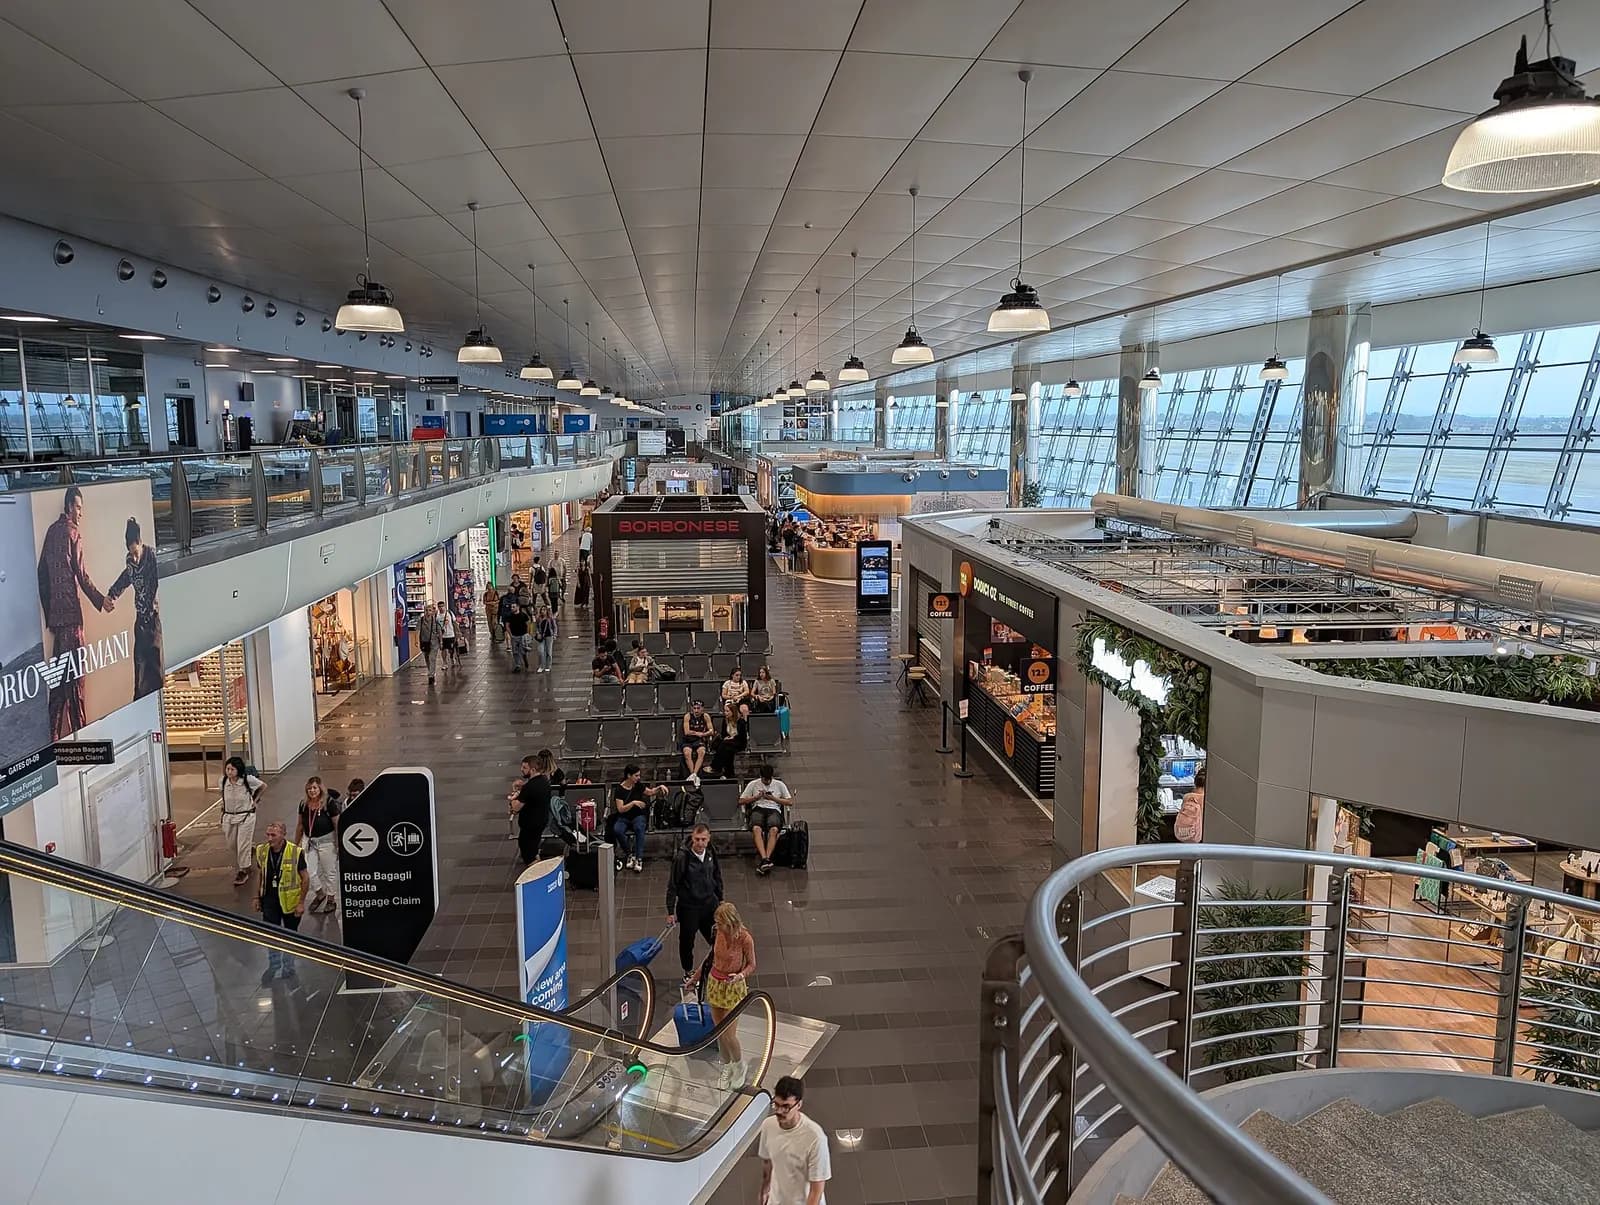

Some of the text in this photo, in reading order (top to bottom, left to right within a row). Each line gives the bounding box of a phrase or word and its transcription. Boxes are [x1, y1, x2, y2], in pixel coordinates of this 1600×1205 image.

[619, 520, 740, 533] BORBONESE
[973, 576, 990, 597] DODICI
[1018, 604, 1035, 619] COFFEE
[0, 630, 130, 709] RIO ARMANI
[1023, 683, 1055, 692] COFFEE
[82, 745, 108, 754] Bagagli
[85, 753, 105, 762] Claim
[8, 753, 40, 776] GATES 01-09
[11, 774, 43, 797] Area Fumatori
[12, 790, 33, 806] Smoking
[344, 871, 412, 882] Ritiro Bagagli
[344, 884, 377, 893] Uscita
[345, 896, 421, 908] Baggage Claim
[345, 909, 365, 918] Exit
[531, 978, 563, 1005] coming
